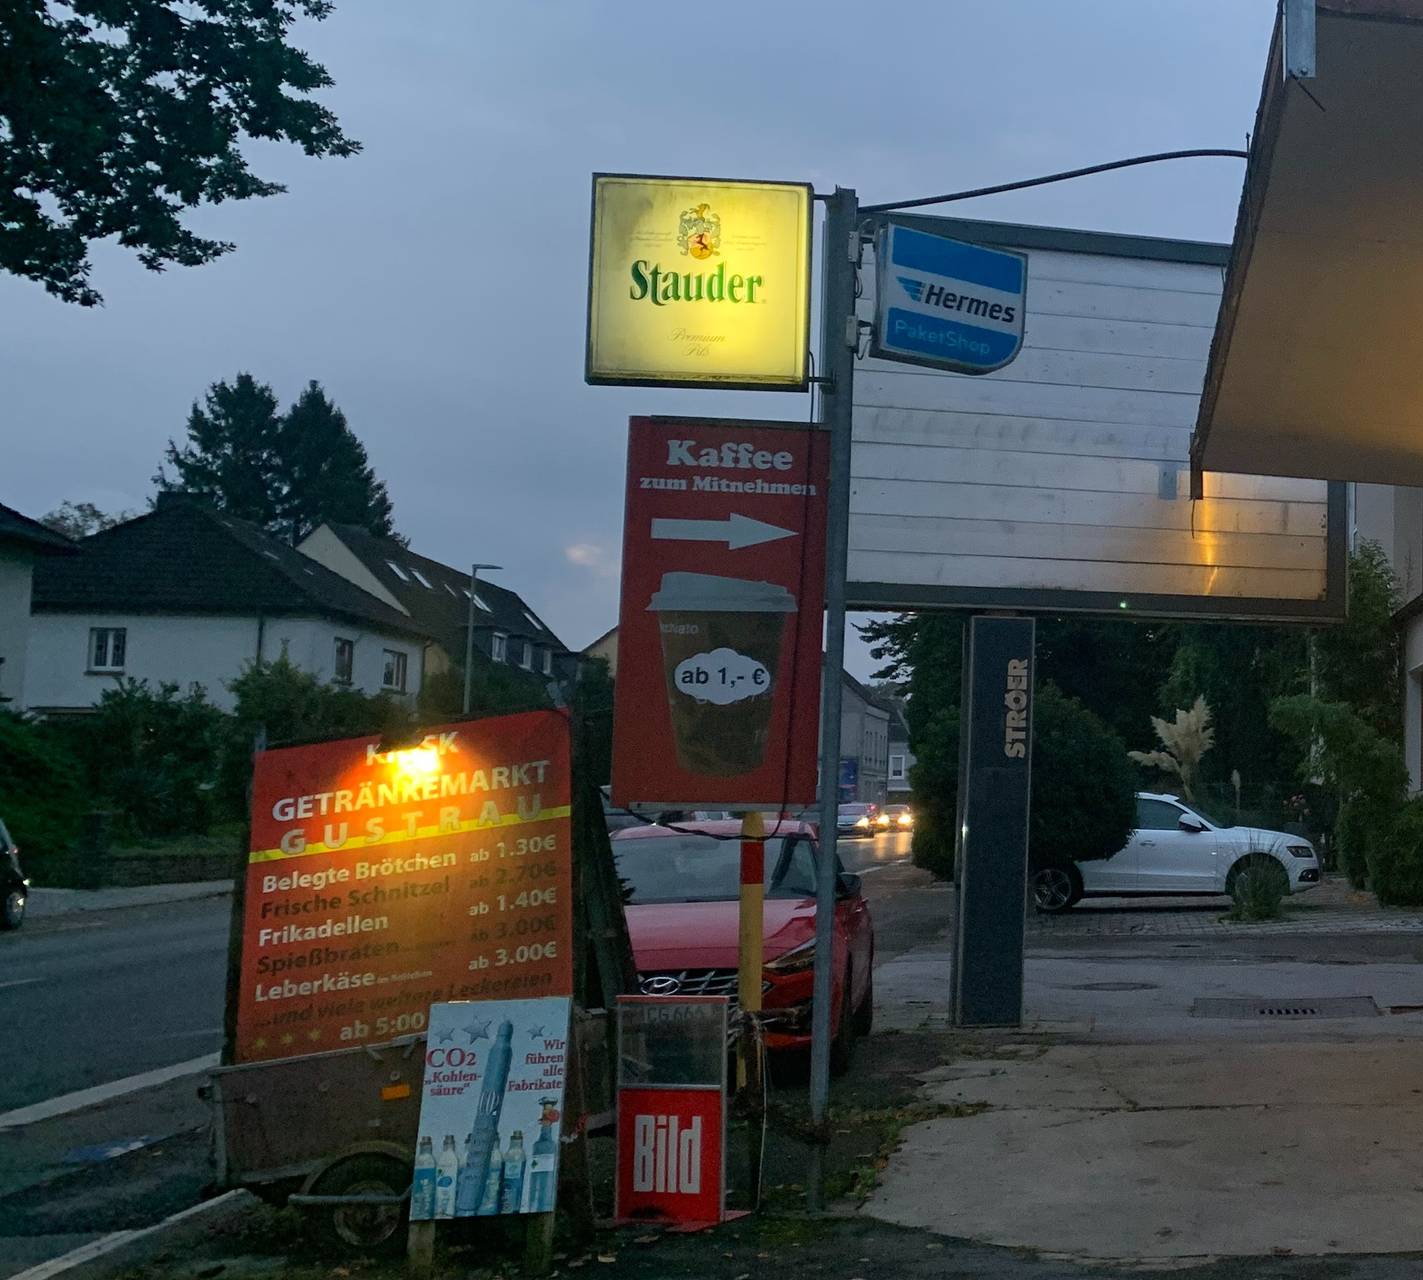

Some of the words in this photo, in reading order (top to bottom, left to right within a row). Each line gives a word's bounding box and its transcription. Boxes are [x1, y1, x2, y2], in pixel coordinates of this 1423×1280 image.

[630, 259, 763, 306] Stauder
[924, 283, 1016, 324] Hermes
[894, 319, 992, 358] PaketShop
[666, 439, 793, 471] Kaffee
[639, 475, 687, 491] zum
[692, 475, 817, 497] Mitnehmen
[681, 667, 709, 685] ab
[718, 667, 745, 688] 1,-
[752, 668, 765, 686] €
[366, 731, 459, 766] KSK
[272, 759, 550, 822] GETRÄNKEMARKT
[262, 866, 350, 894] Belegte
[355, 851, 457, 880] Brötchen
[469, 848, 490, 863] ab
[496, 834, 557, 858] 1.30€
[261, 894, 342, 919] Frische
[348, 875, 449, 907] Schnitzel
[258, 915, 389, 948] Frikadellen
[468, 901, 489, 917] ab
[496, 887, 557, 912] 1.40€
[255, 971, 377, 1002] Leberkäse
[468, 955, 489, 971] ab
[495, 941, 557, 967] 3.00€
[256, 941, 399, 977] Spießbraten
[340, 1019, 369, 1041] ab
[375, 1011, 426, 1036] 5:00
[426, 1047, 476, 1069] CO2
[524, 1053, 564, 1065] führen
[543, 1039, 566, 1050] Wir
[507, 1080, 563, 1093] Fabrikate
[542, 1066, 563, 1077] alle
[633, 1114, 703, 1194] Bild
